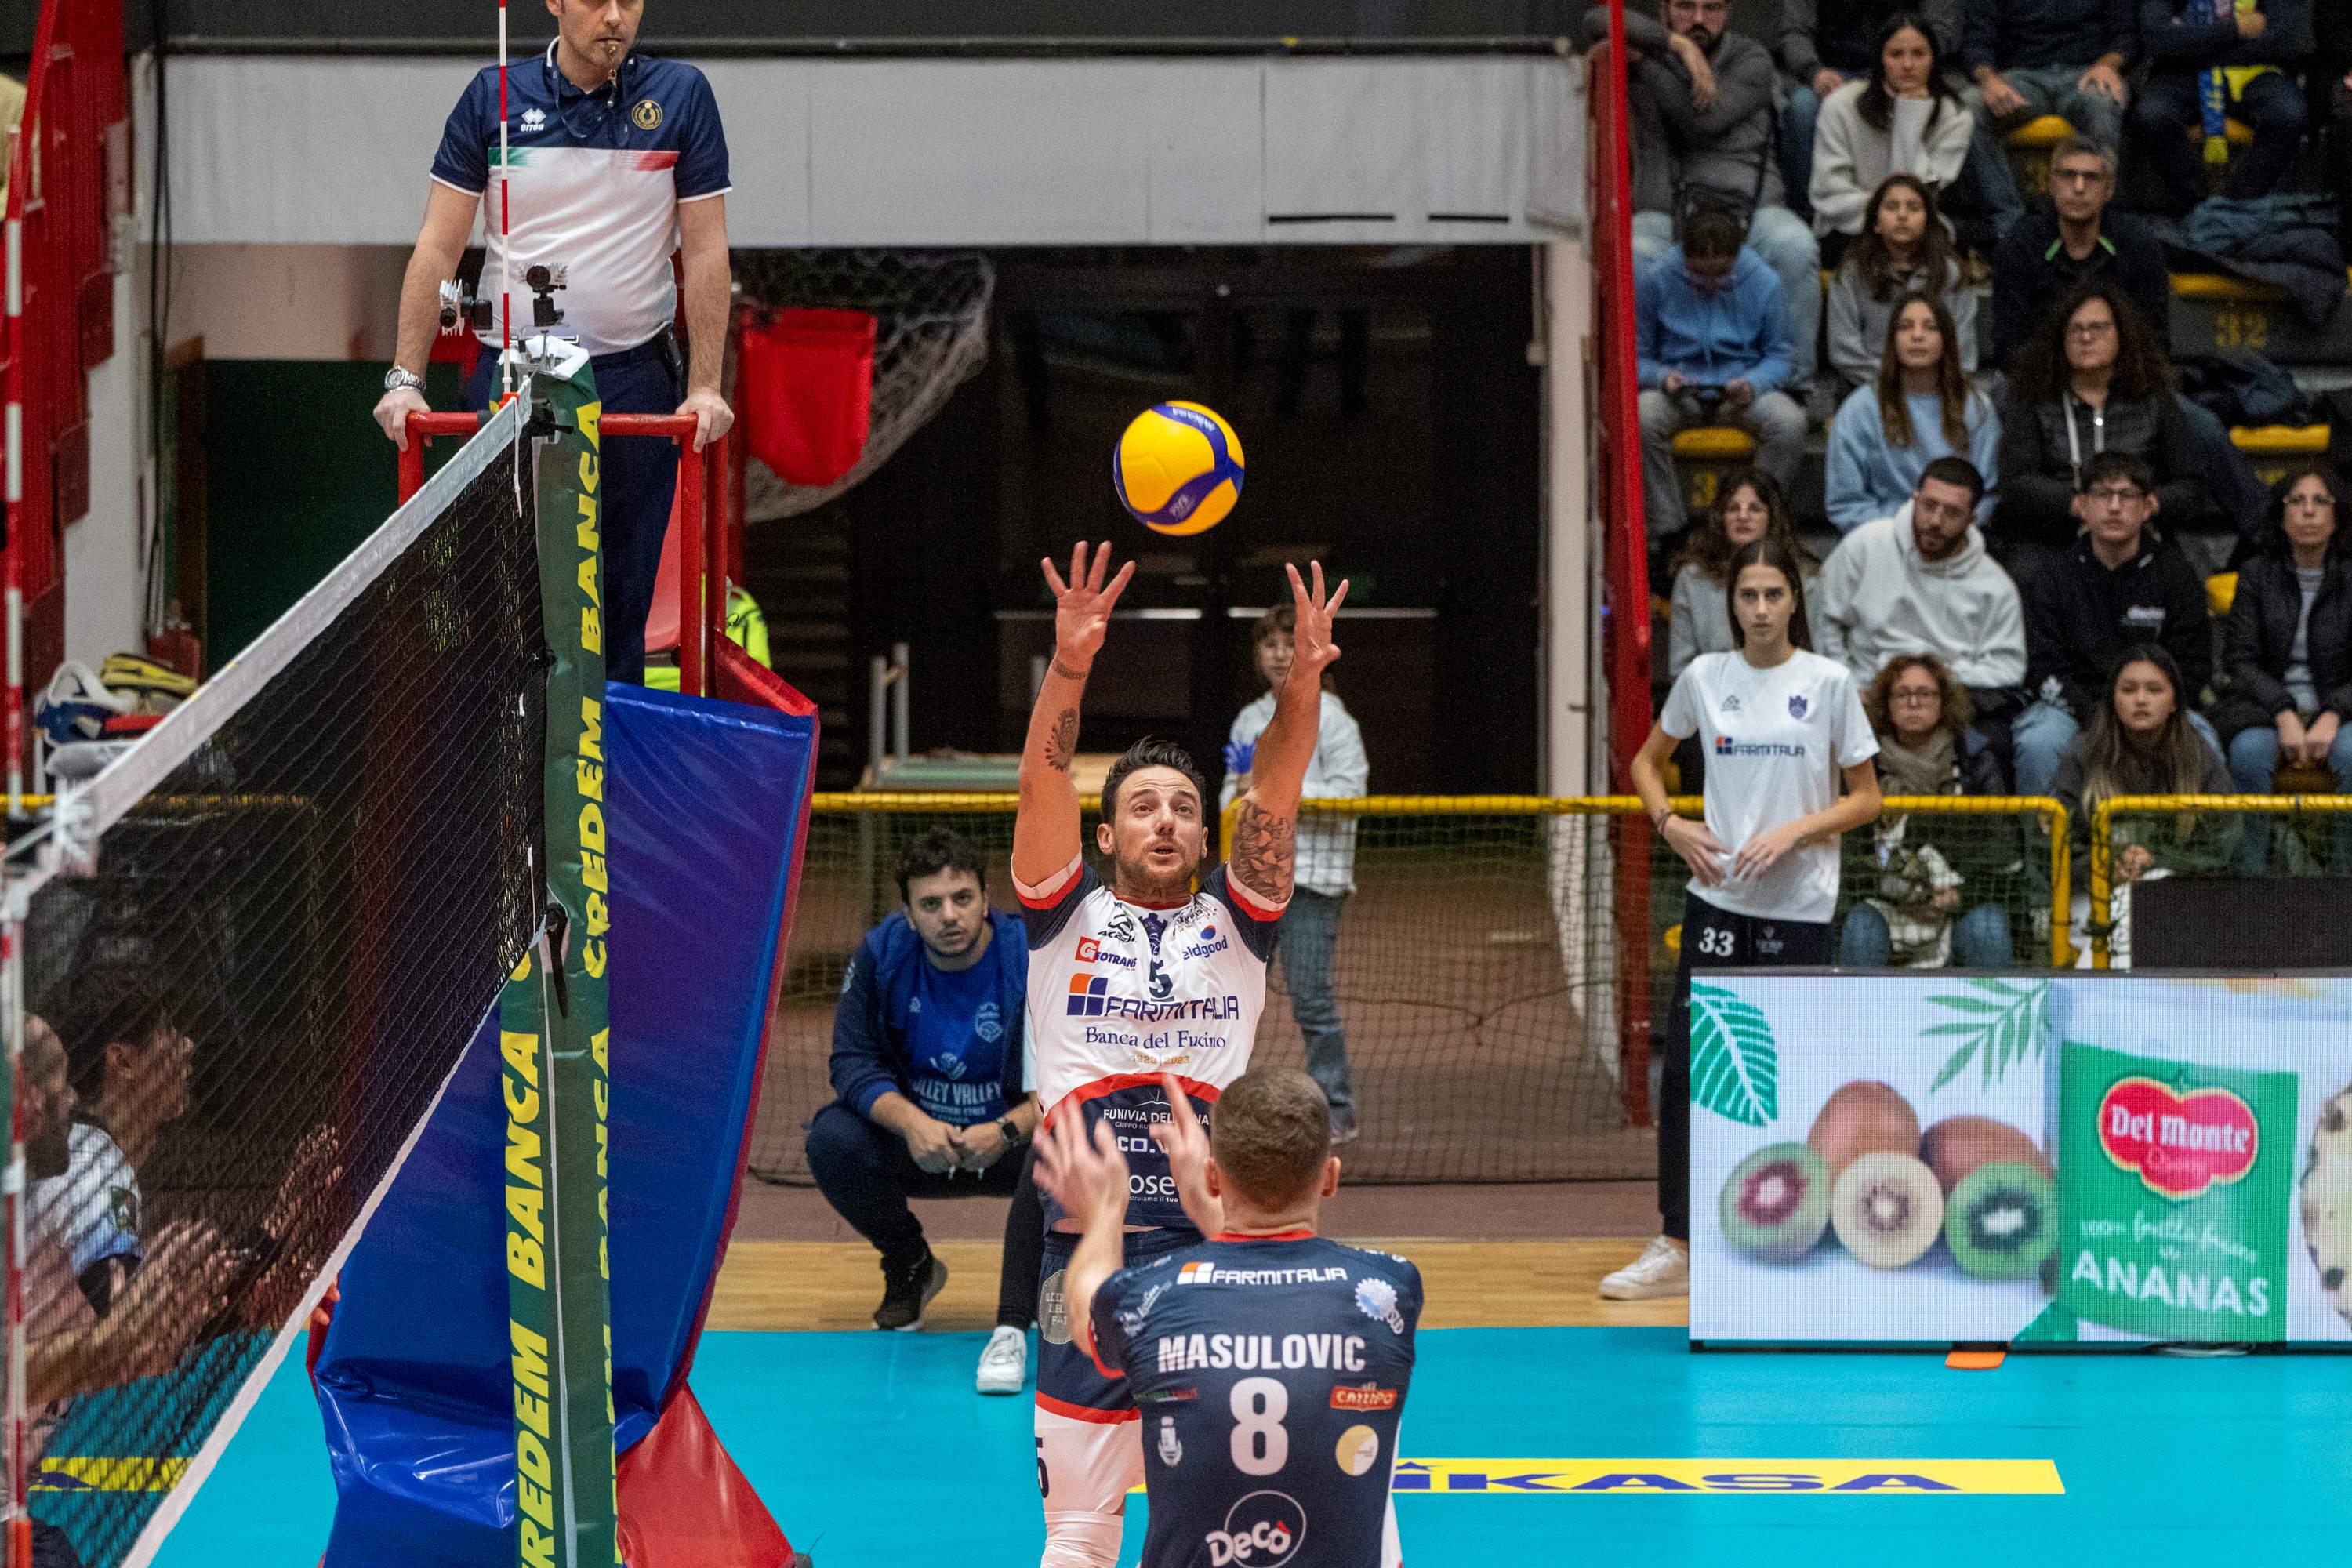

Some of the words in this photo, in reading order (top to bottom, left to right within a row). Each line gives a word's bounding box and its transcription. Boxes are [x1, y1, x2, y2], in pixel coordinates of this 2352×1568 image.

[576, 401, 602, 655] BANCA
[576, 695, 611, 978] CREDEM
[1080, 942, 1137, 968] GEOTRANS
[1698, 927, 1735, 956] 33
[1149, 958, 1174, 999] 5
[1104, 996, 1240, 1023] FARMITALIA
[1085, 1026, 1138, 1047] Banca
[1143, 1032, 1169, 1049] del
[1177, 1030, 1226, 1048] Fucino
[1103, 1109, 1147, 1122] FUNIVIA
[2111, 1104, 2154, 1143] Del
[2159, 1115, 2251, 1153] Monte
[500, 1029, 546, 1292] BANCA
[1212, 1267, 1348, 1286] FARMITALIA
[2071, 1250, 2270, 1317] ANANAS
[1157, 1333, 1366, 1373] MASULOVIC
[510, 1319, 556, 1568] REDEM
[1229, 1376, 1289, 1476] 8
[1392, 1466, 1965, 1490] IKASA
